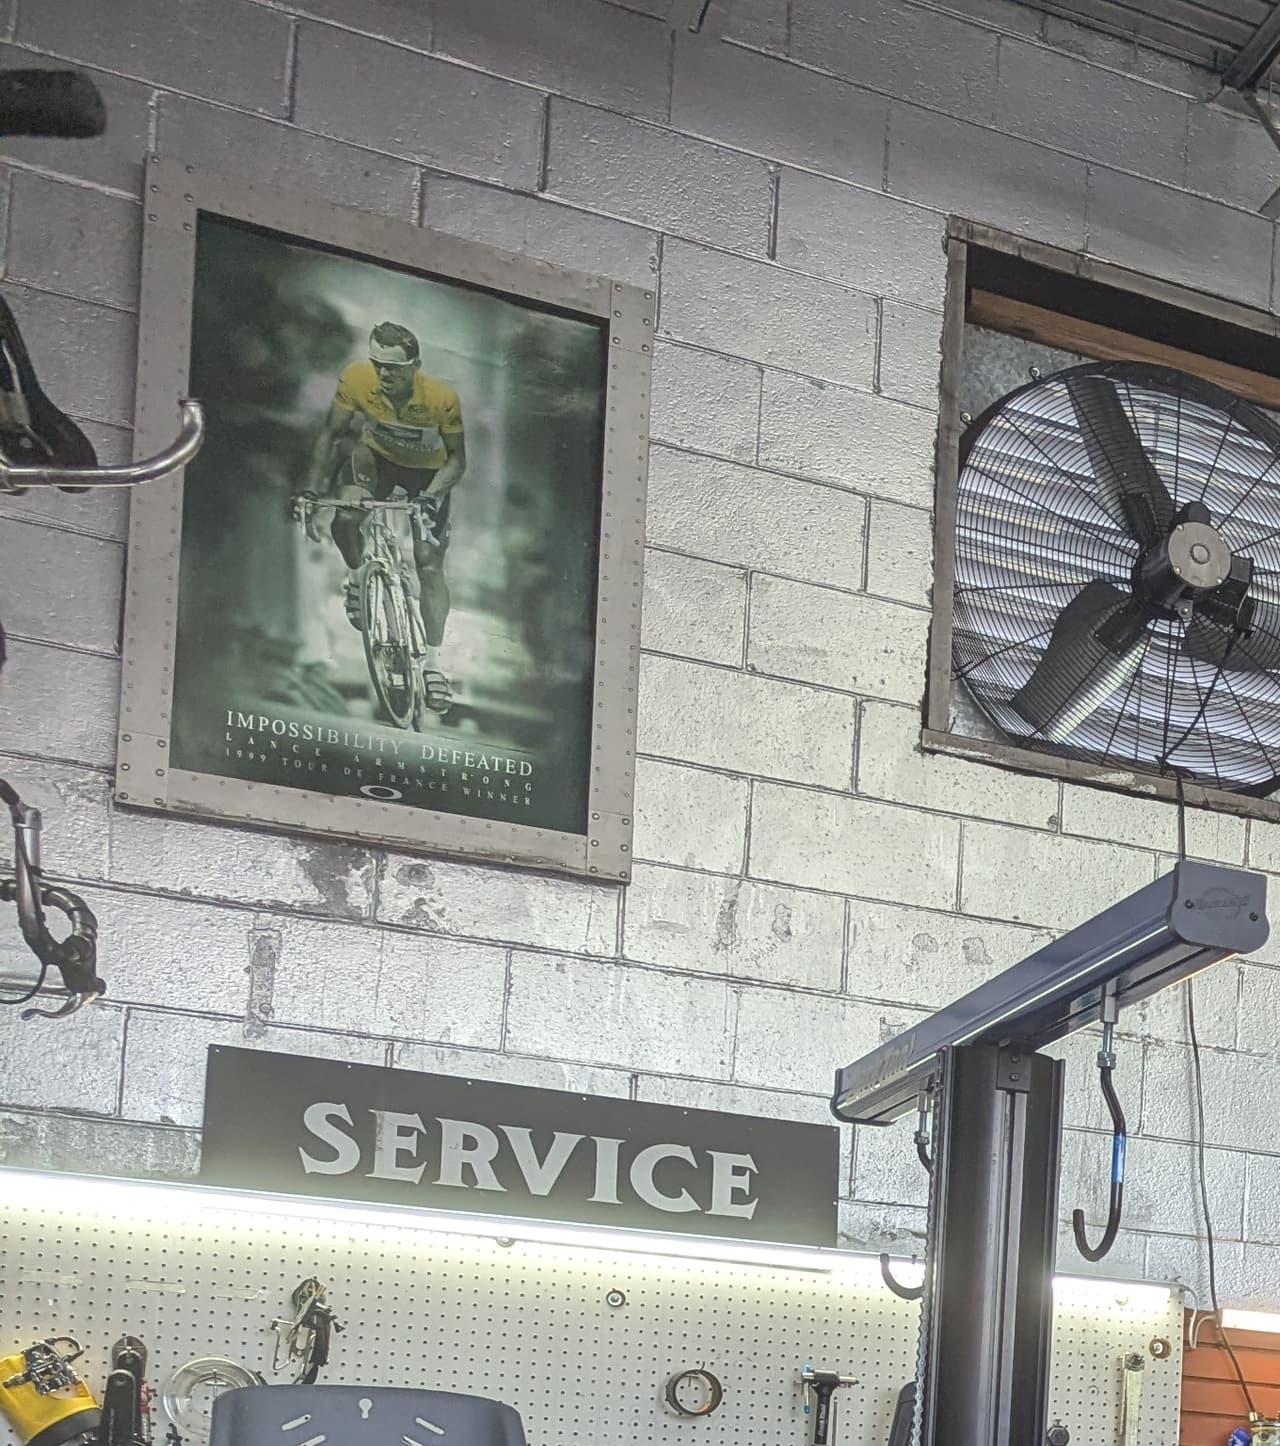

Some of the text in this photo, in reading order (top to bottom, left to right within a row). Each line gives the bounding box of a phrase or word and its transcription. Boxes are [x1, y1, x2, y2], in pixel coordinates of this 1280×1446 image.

[225, 732, 533, 791] LANCE ARMSTRONG
[227, 710, 533, 776] IMPOSSIBILITY DEFEATED
[225, 748, 532, 806] 1999 TOUR DE FRANCE WINNER
[299, 1101, 759, 1221] SERVICE
